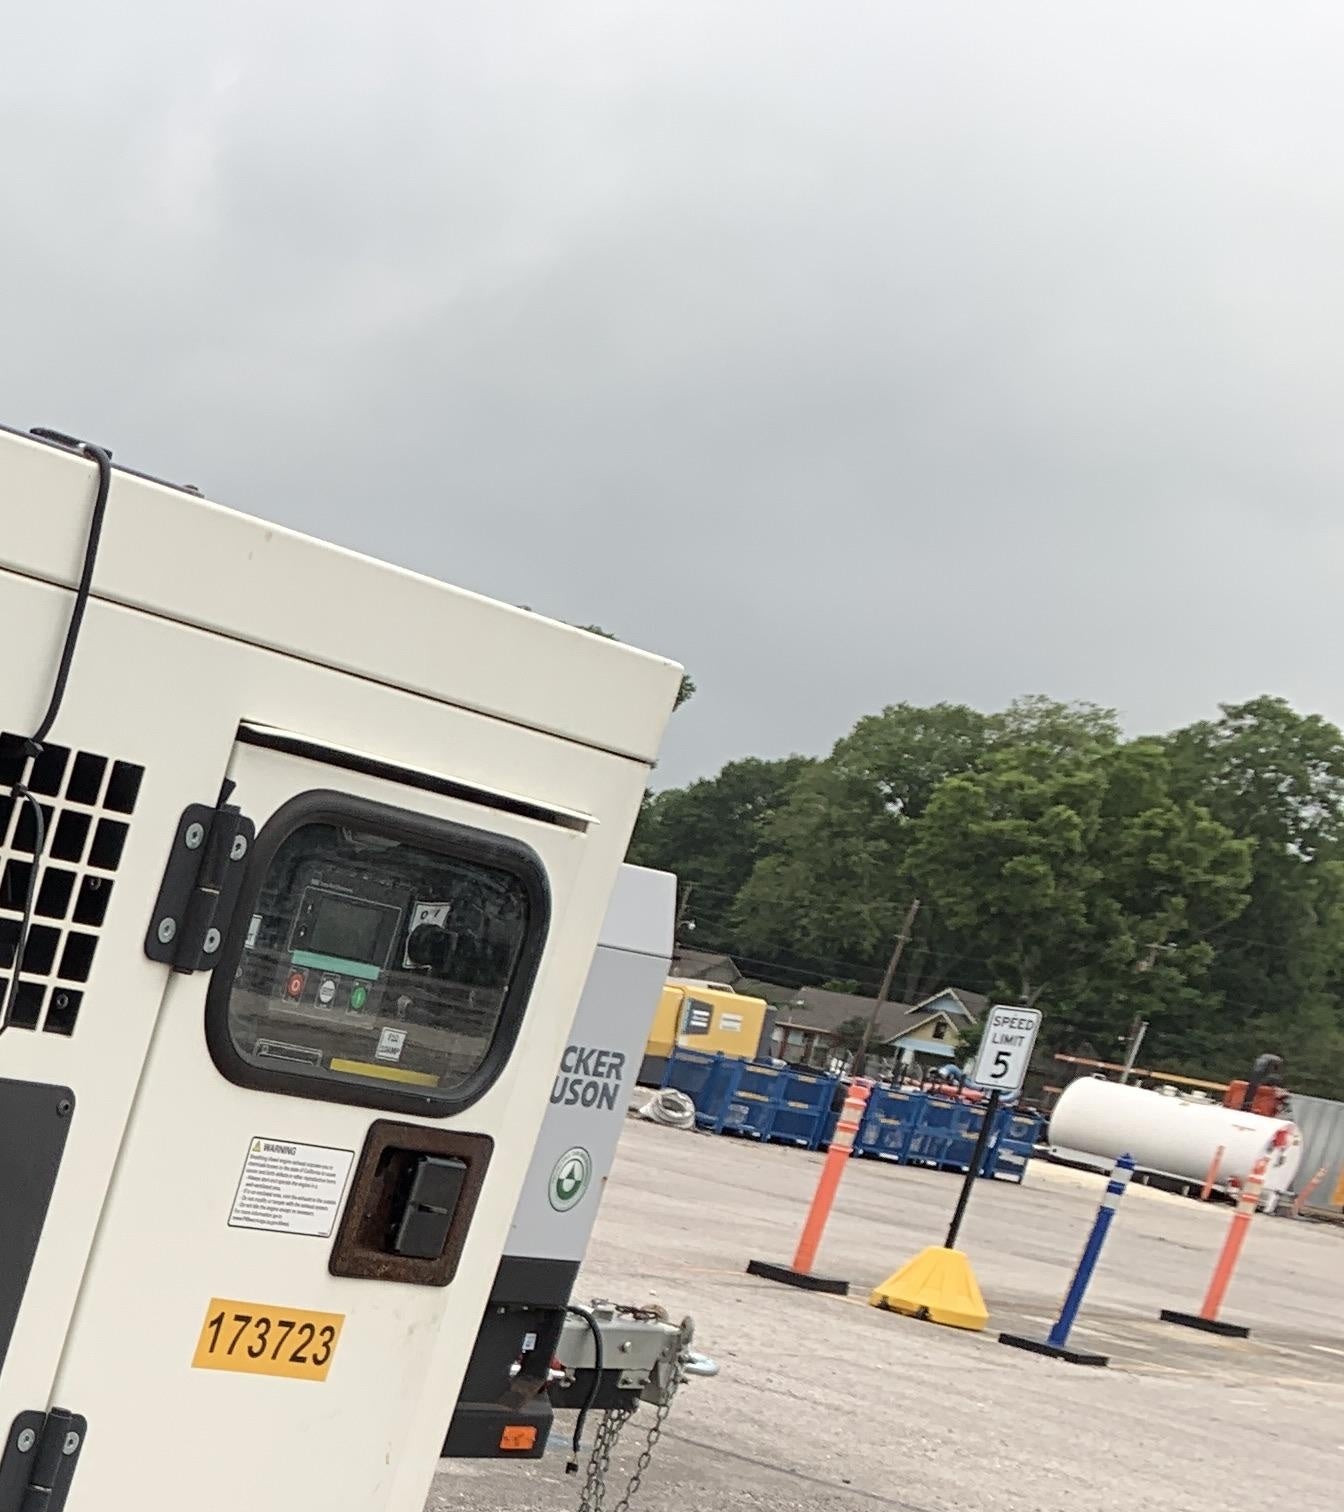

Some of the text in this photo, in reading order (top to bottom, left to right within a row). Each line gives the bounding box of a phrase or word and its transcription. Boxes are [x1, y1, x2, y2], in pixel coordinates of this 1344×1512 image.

[992, 1015, 1034, 1031] SPEED
[992, 1032, 1025, 1048] LIMIT
[560, 1045, 626, 1081] CKER
[990, 1050, 1011, 1079] 5
[549, 1075, 620, 1111] USON
[263, 1142, 297, 1156] WARNING
[208, 1311, 336, 1366] 173723
